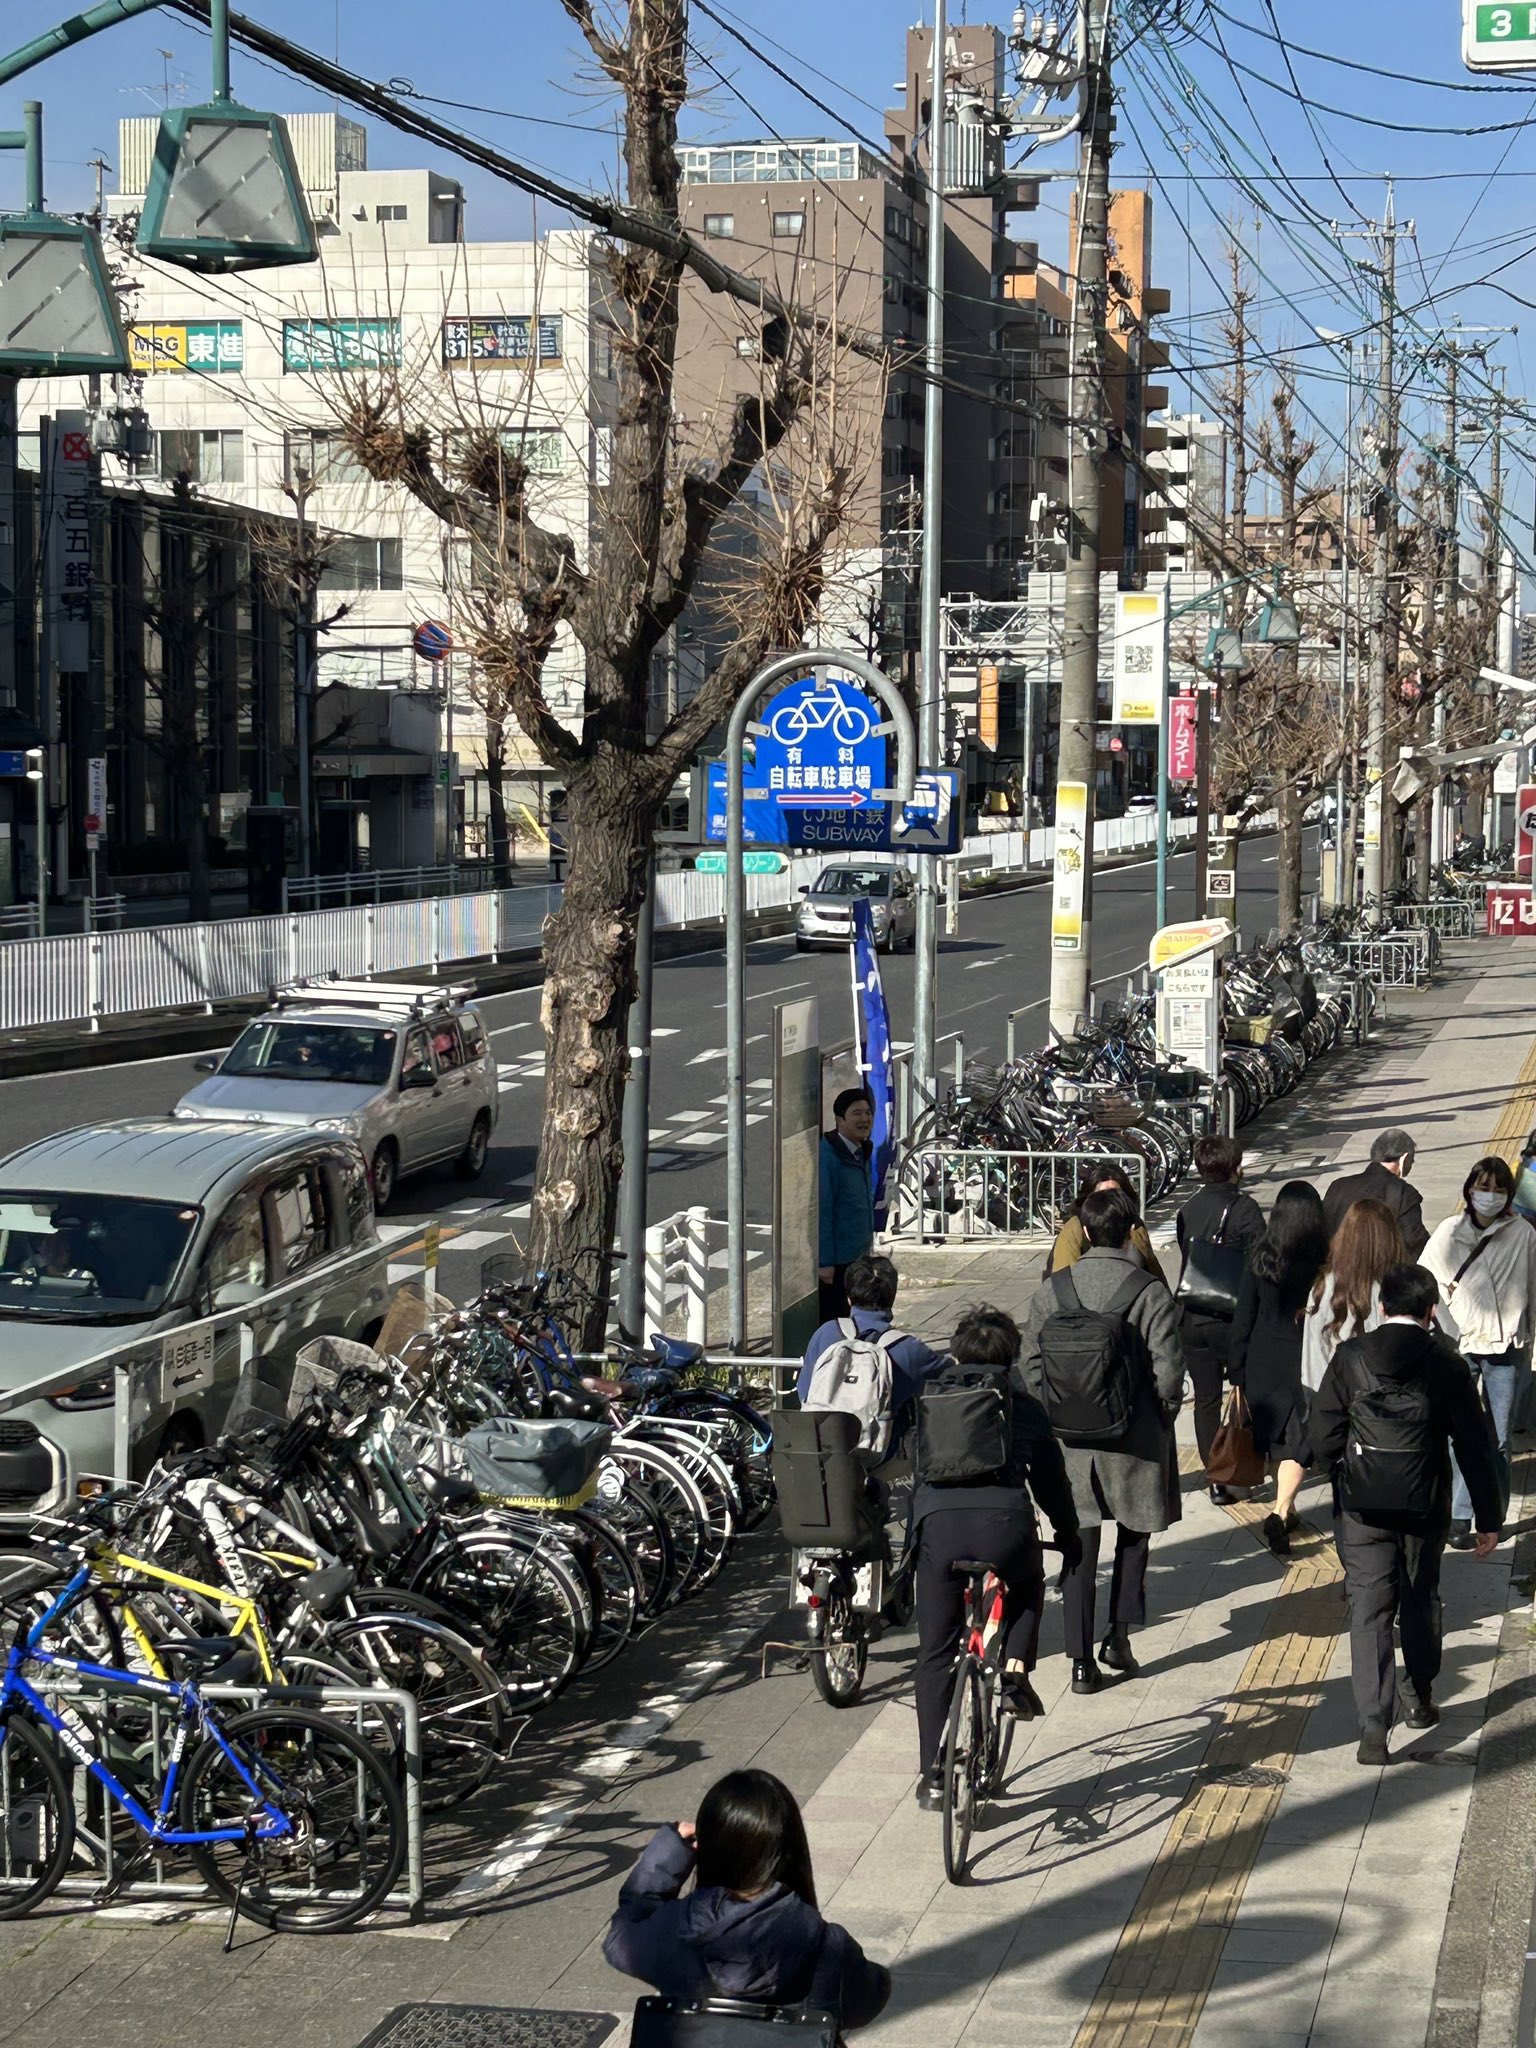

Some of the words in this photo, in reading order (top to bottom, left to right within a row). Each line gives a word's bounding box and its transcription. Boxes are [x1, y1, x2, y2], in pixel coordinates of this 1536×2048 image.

[134, 336, 179, 351] MSG
[187, 333, 243, 362] 東進
[1174, 704, 1191, 775] ホームメイト
[770, 766, 871, 789] 自転車駐車場
[802, 825, 884, 842] SUBWAY
[1166, 969, 1209, 978] お支払いは
[1168, 984, 1206, 993] こちらです
